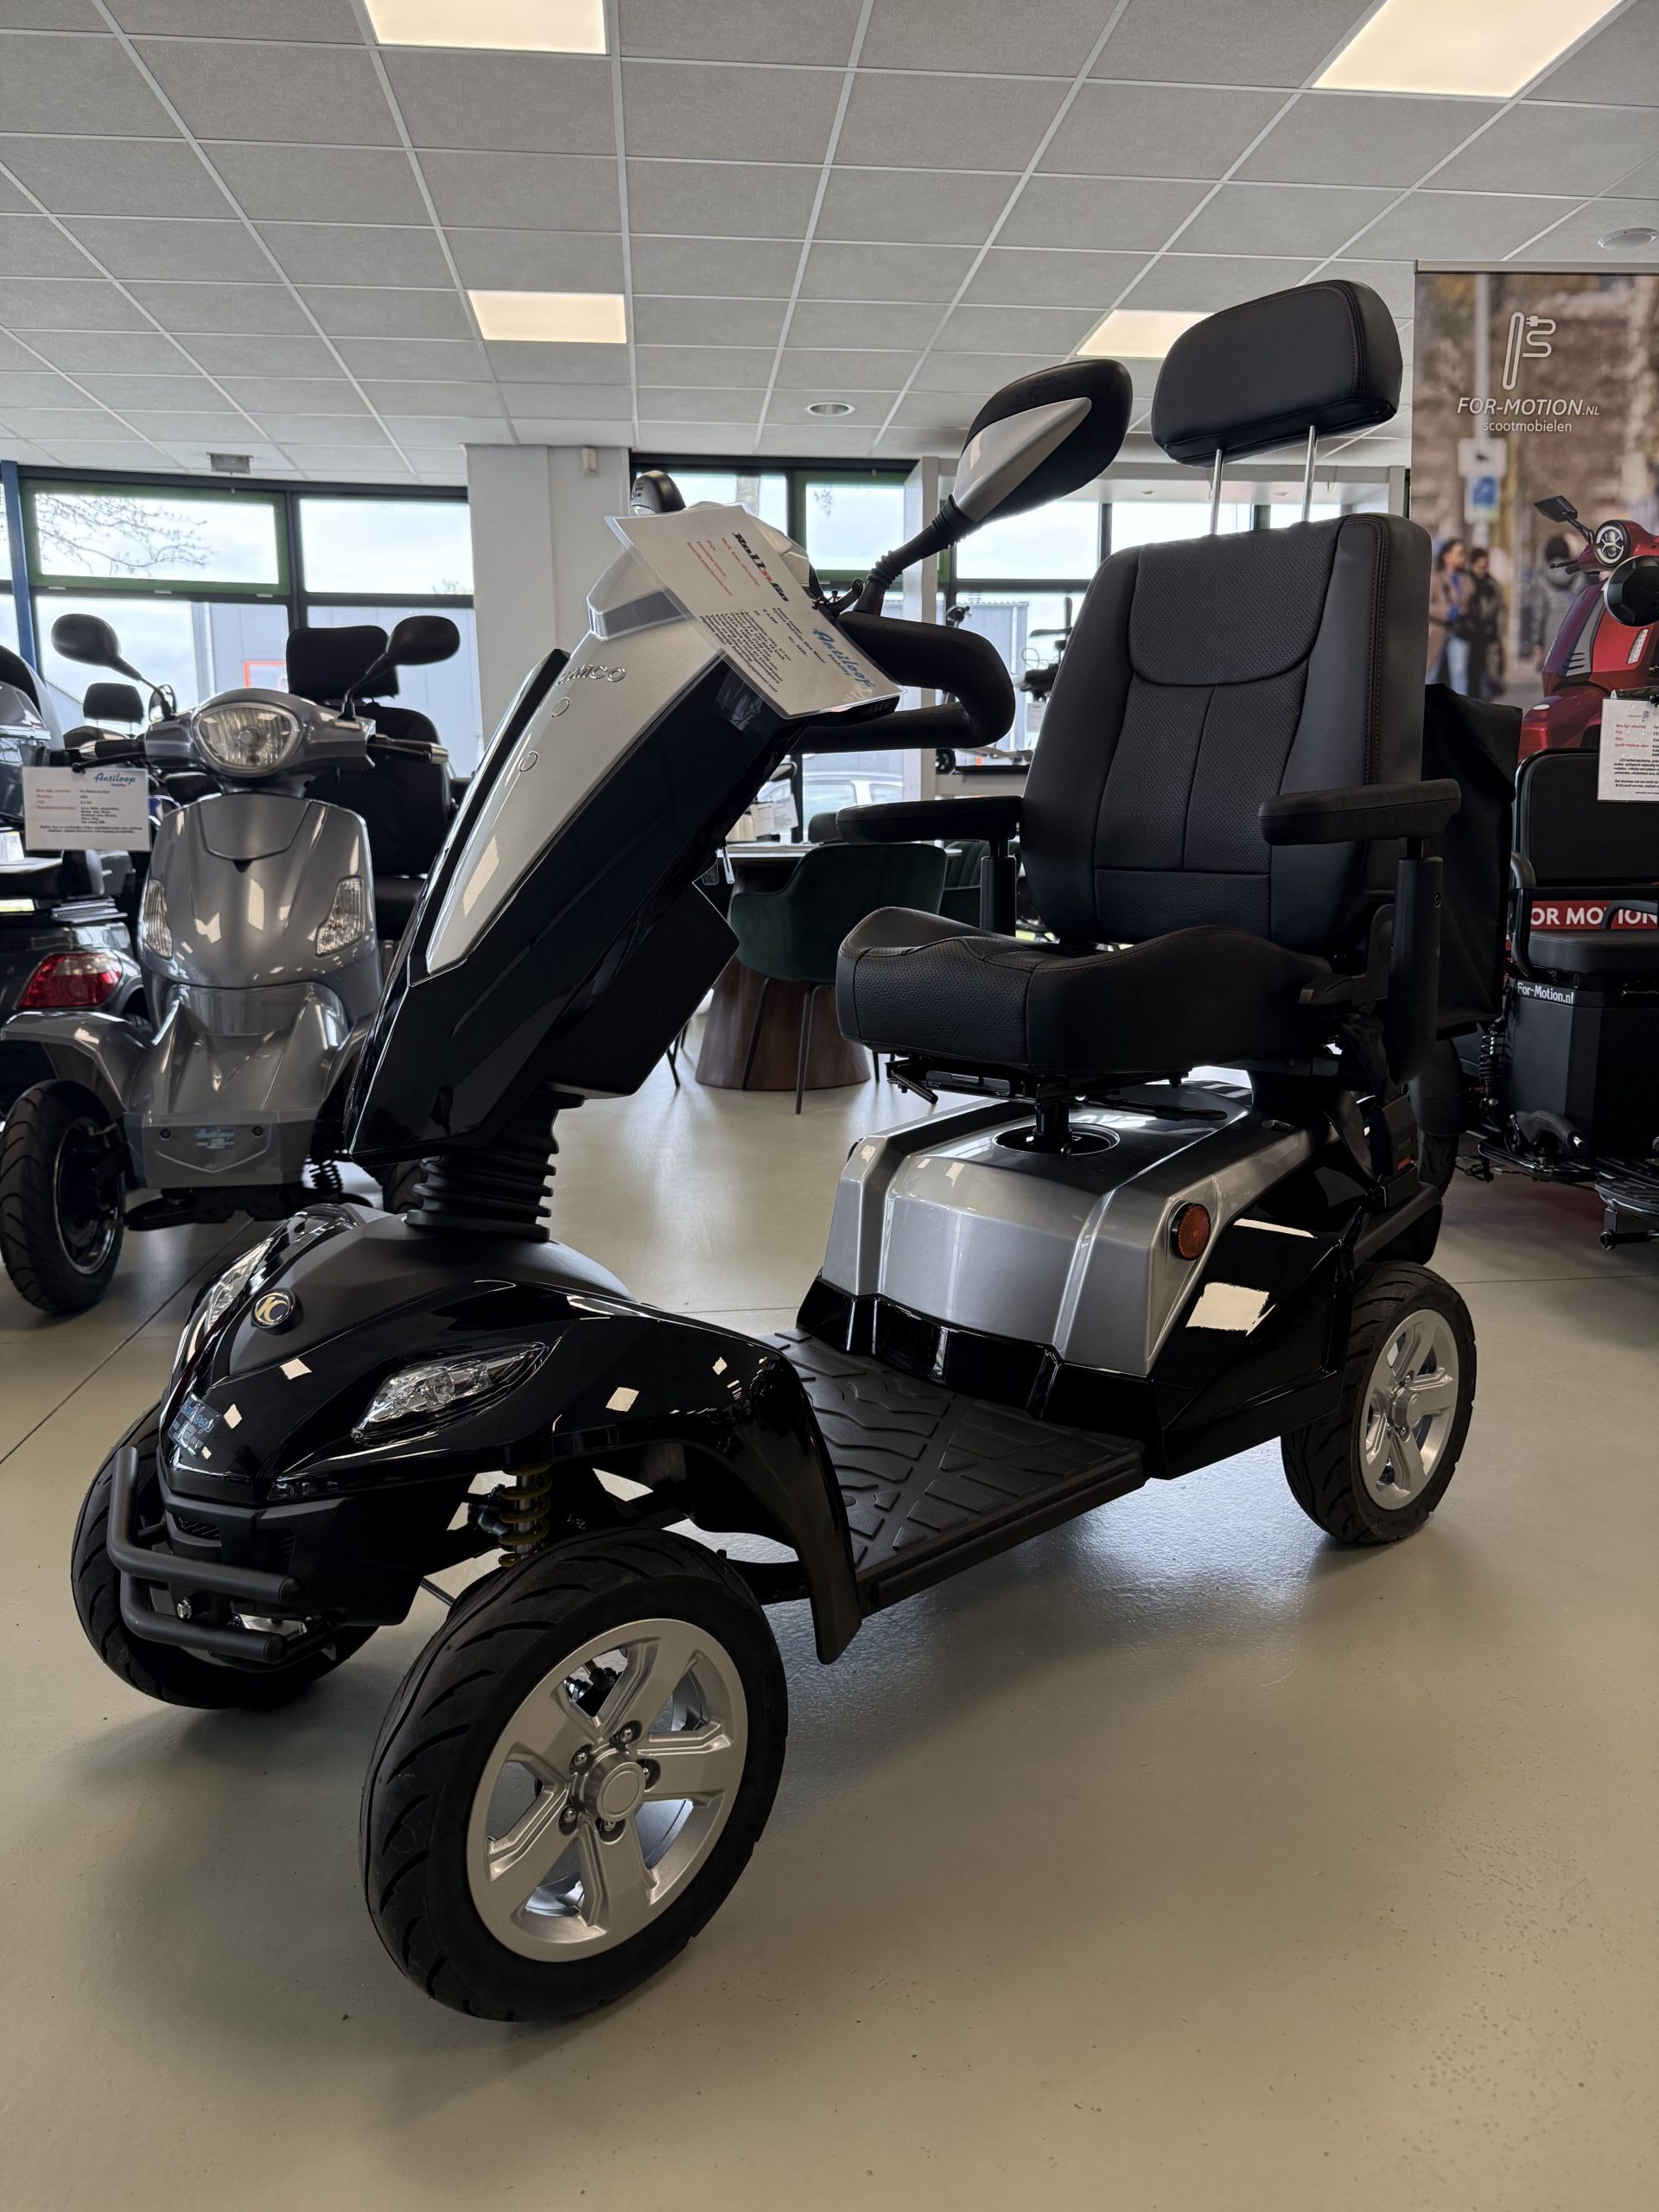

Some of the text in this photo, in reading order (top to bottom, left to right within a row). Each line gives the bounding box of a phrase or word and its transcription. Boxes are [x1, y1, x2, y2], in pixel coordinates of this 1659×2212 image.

[1457, 397, 1599, 416] FOR-MOTION.NL
[1483, 419, 1573, 432] scootmobielen
[812, 628, 875, 688] Antiloop
[94, 772, 136, 788] Antiloop
[1531, 907, 1658, 925] OR MOION
[1517, 982, 1574, 1004] For-Motion.nl
